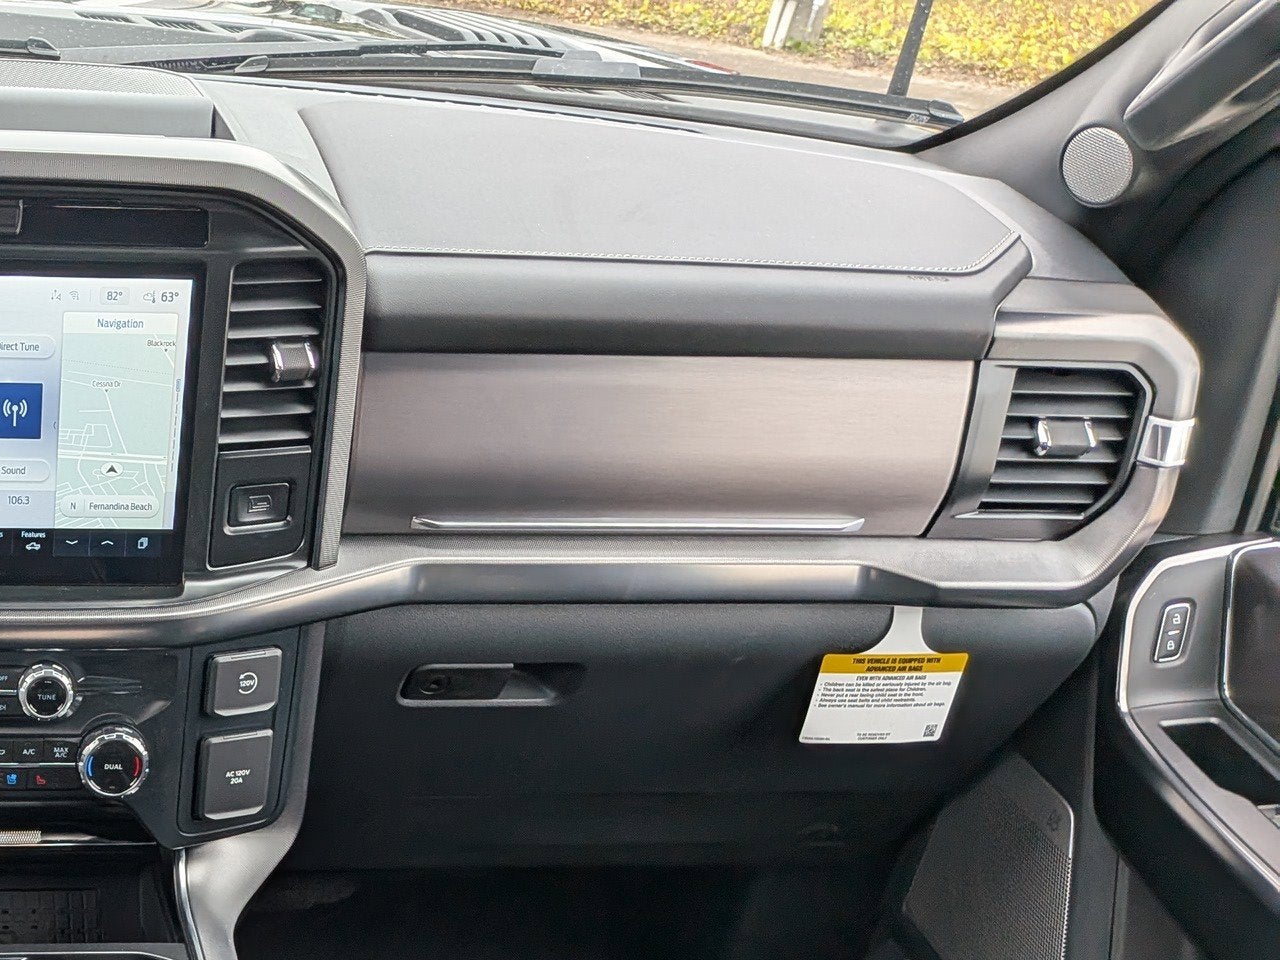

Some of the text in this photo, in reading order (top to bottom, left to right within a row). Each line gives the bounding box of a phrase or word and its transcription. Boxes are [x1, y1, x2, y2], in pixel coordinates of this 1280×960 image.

[106, 291, 122, 301] 82°
[161, 292, 180, 302] 63°
[97, 318, 144, 330] Navigation
[20, 343, 40, 352] Tune
[147, 339, 176, 348] Blackrock
[92, 380, 114, 388] Cessna
[1, 466, 26, 475] Sound
[8, 496, 30, 505] 106.3
[89, 502, 130, 510] Fernandina
[130, 503, 152, 511] Beach
